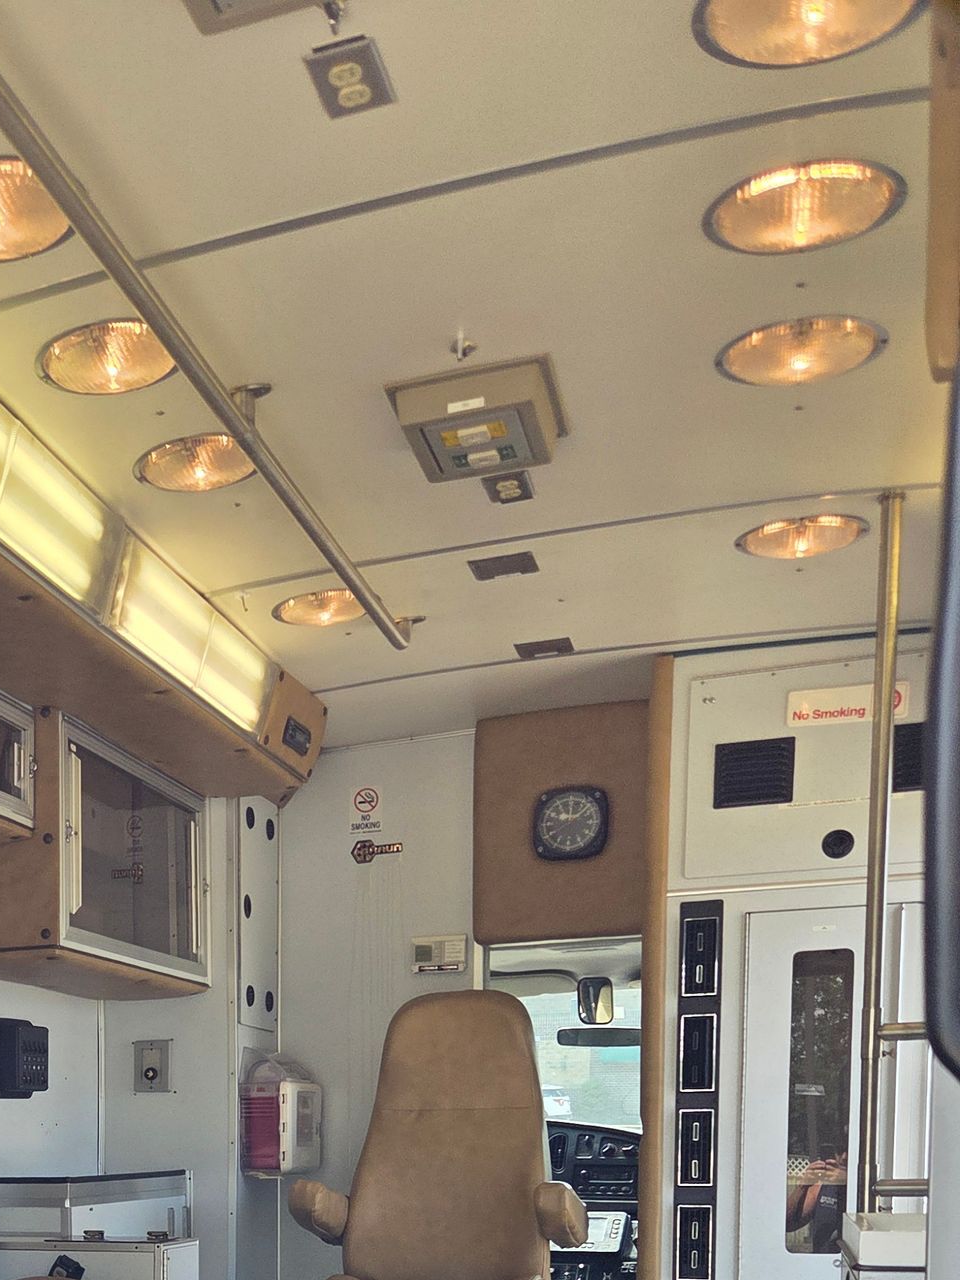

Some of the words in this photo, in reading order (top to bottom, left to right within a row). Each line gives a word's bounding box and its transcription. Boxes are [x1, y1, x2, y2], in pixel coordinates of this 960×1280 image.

[792, 710, 810, 721] No
[812, 707, 866, 720] Smoking
[351, 821, 380, 830] SMOKING
